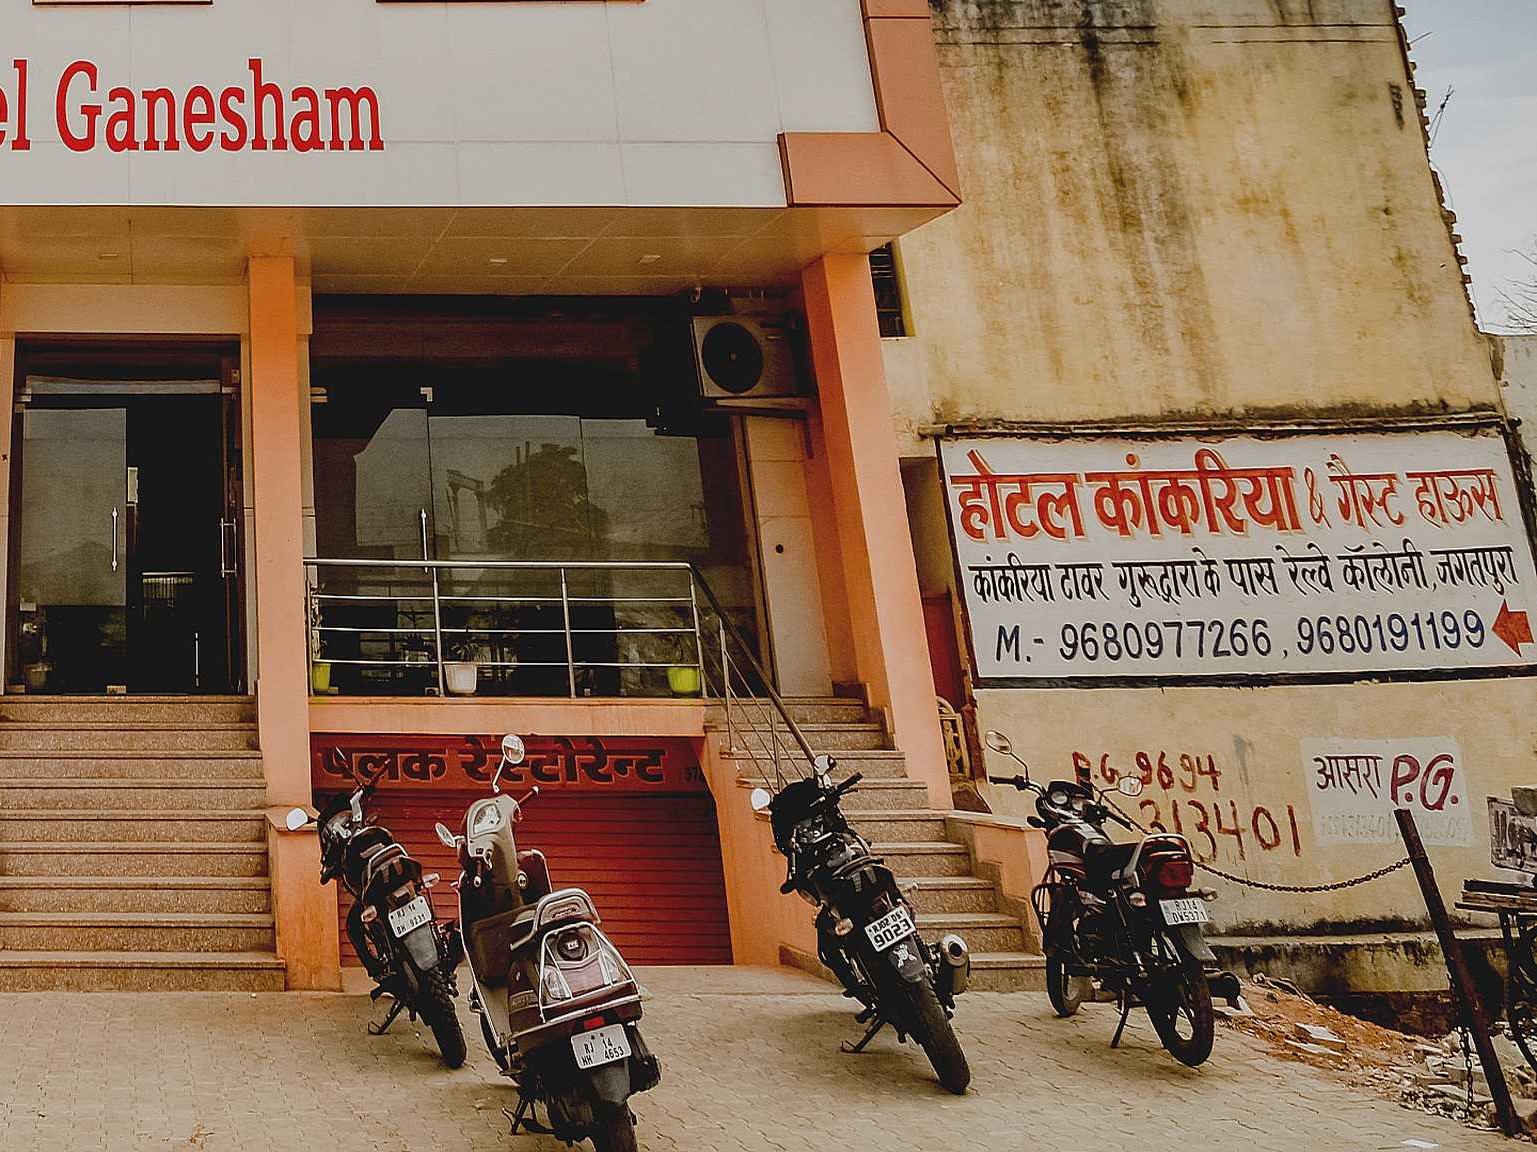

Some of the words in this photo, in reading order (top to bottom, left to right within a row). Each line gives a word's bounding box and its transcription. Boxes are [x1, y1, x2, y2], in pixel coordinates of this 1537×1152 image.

[56, 58, 384, 152] Ganesham
[950, 450, 1085, 540] होटल
[1085, 448, 1302, 537] कांकरिया
[1304, 466, 1331, 529] &
[968, 552, 1055, 602] कांकरिया
[1223, 558, 1279, 596] पास
[1297, 610, 1485, 655] 9680191199
[1313, 755, 1383, 799] आसरा
[1391, 754, 1459, 810] P.G.
[874, 918, 912, 948] 9023
